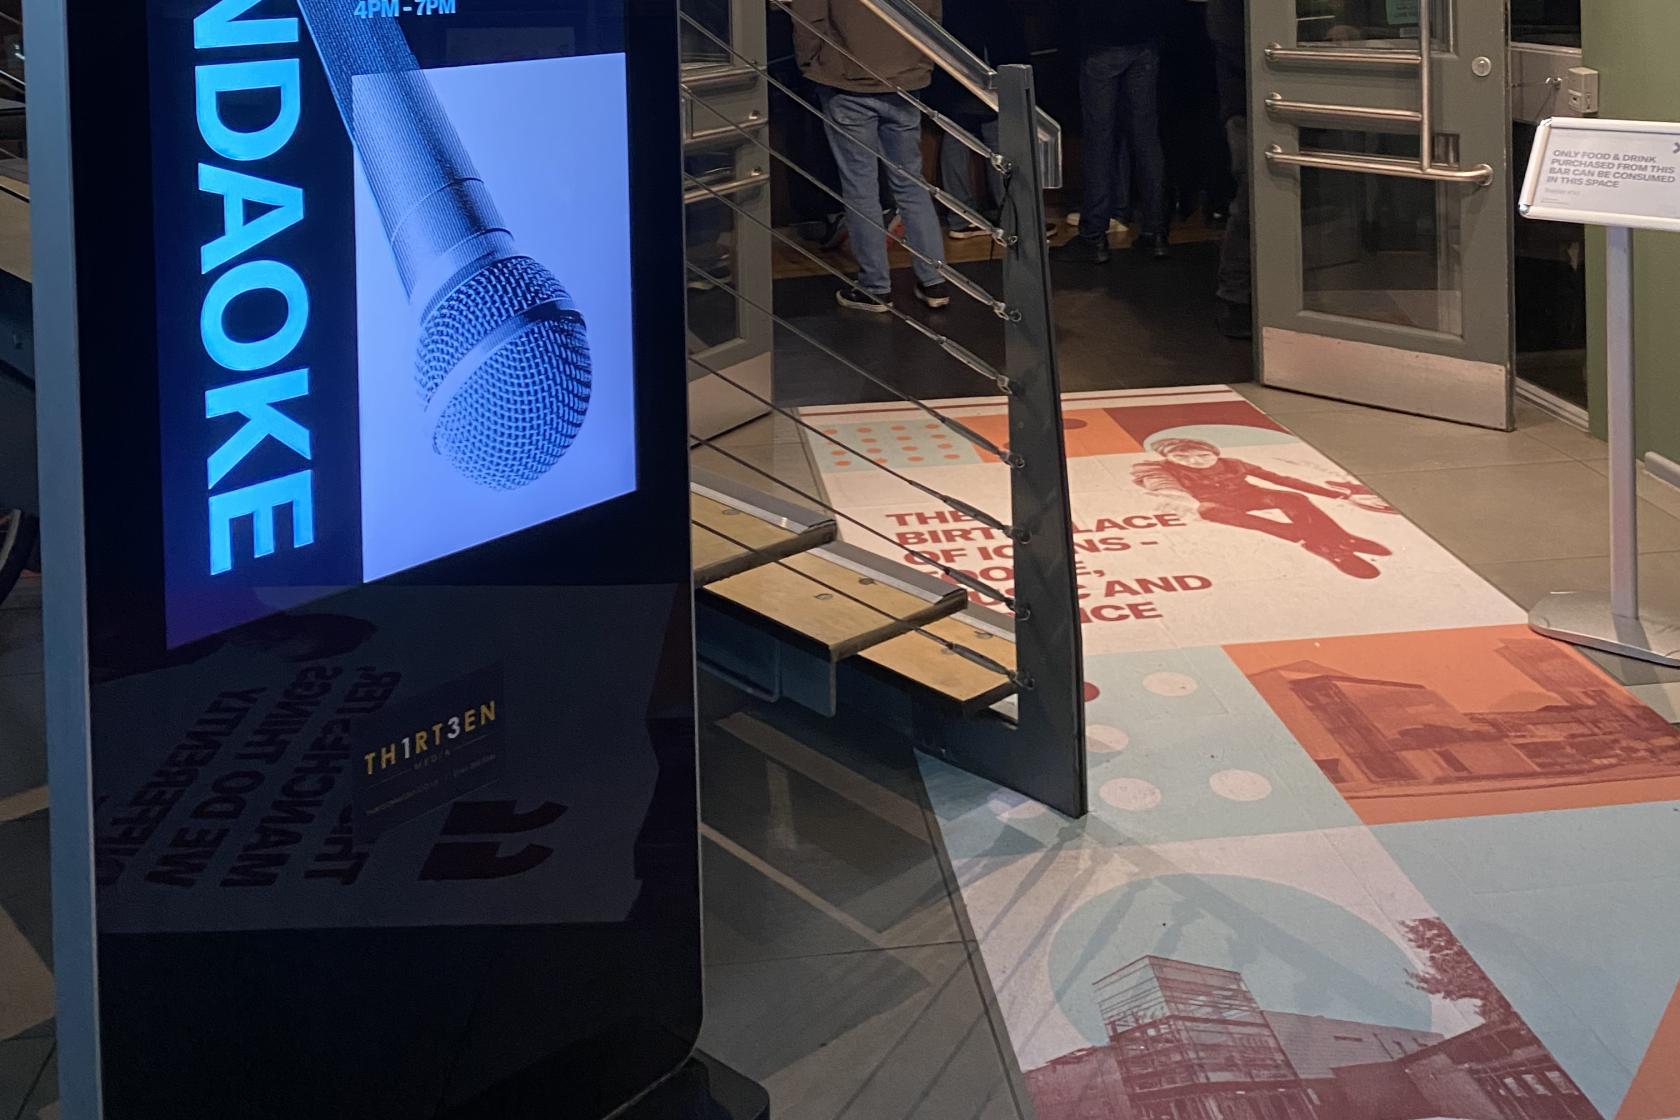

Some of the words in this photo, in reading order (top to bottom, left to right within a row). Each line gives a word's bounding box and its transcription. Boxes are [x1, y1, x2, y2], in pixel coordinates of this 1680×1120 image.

[1553, 149, 1580, 159] ONLY
[1581, 151, 1612, 161] FOOD
[1612, 153, 1620, 161] &
[1622, 154, 1657, 164] DRINK
[1551, 158, 1615, 170] PURCHASED
[1616, 163, 1648, 172] FROM
[1650, 165, 1676, 174] THIS
[1546, 176, 1558, 184] IN
[1560, 177, 1583, 186] THIS
[1584, 178, 1620, 188] SPACE
[1549, 167, 1570, 176] BAR
[1572, 168, 1595, 178] CAN
[1597, 170, 1611, 179] BE
[1612, 171, 1676, 183] CONSUMED
[903, 547, 967, 567] OF
[1104, 574, 1213, 598] AND
[363, 699, 497, 776] TH1RT3EN
